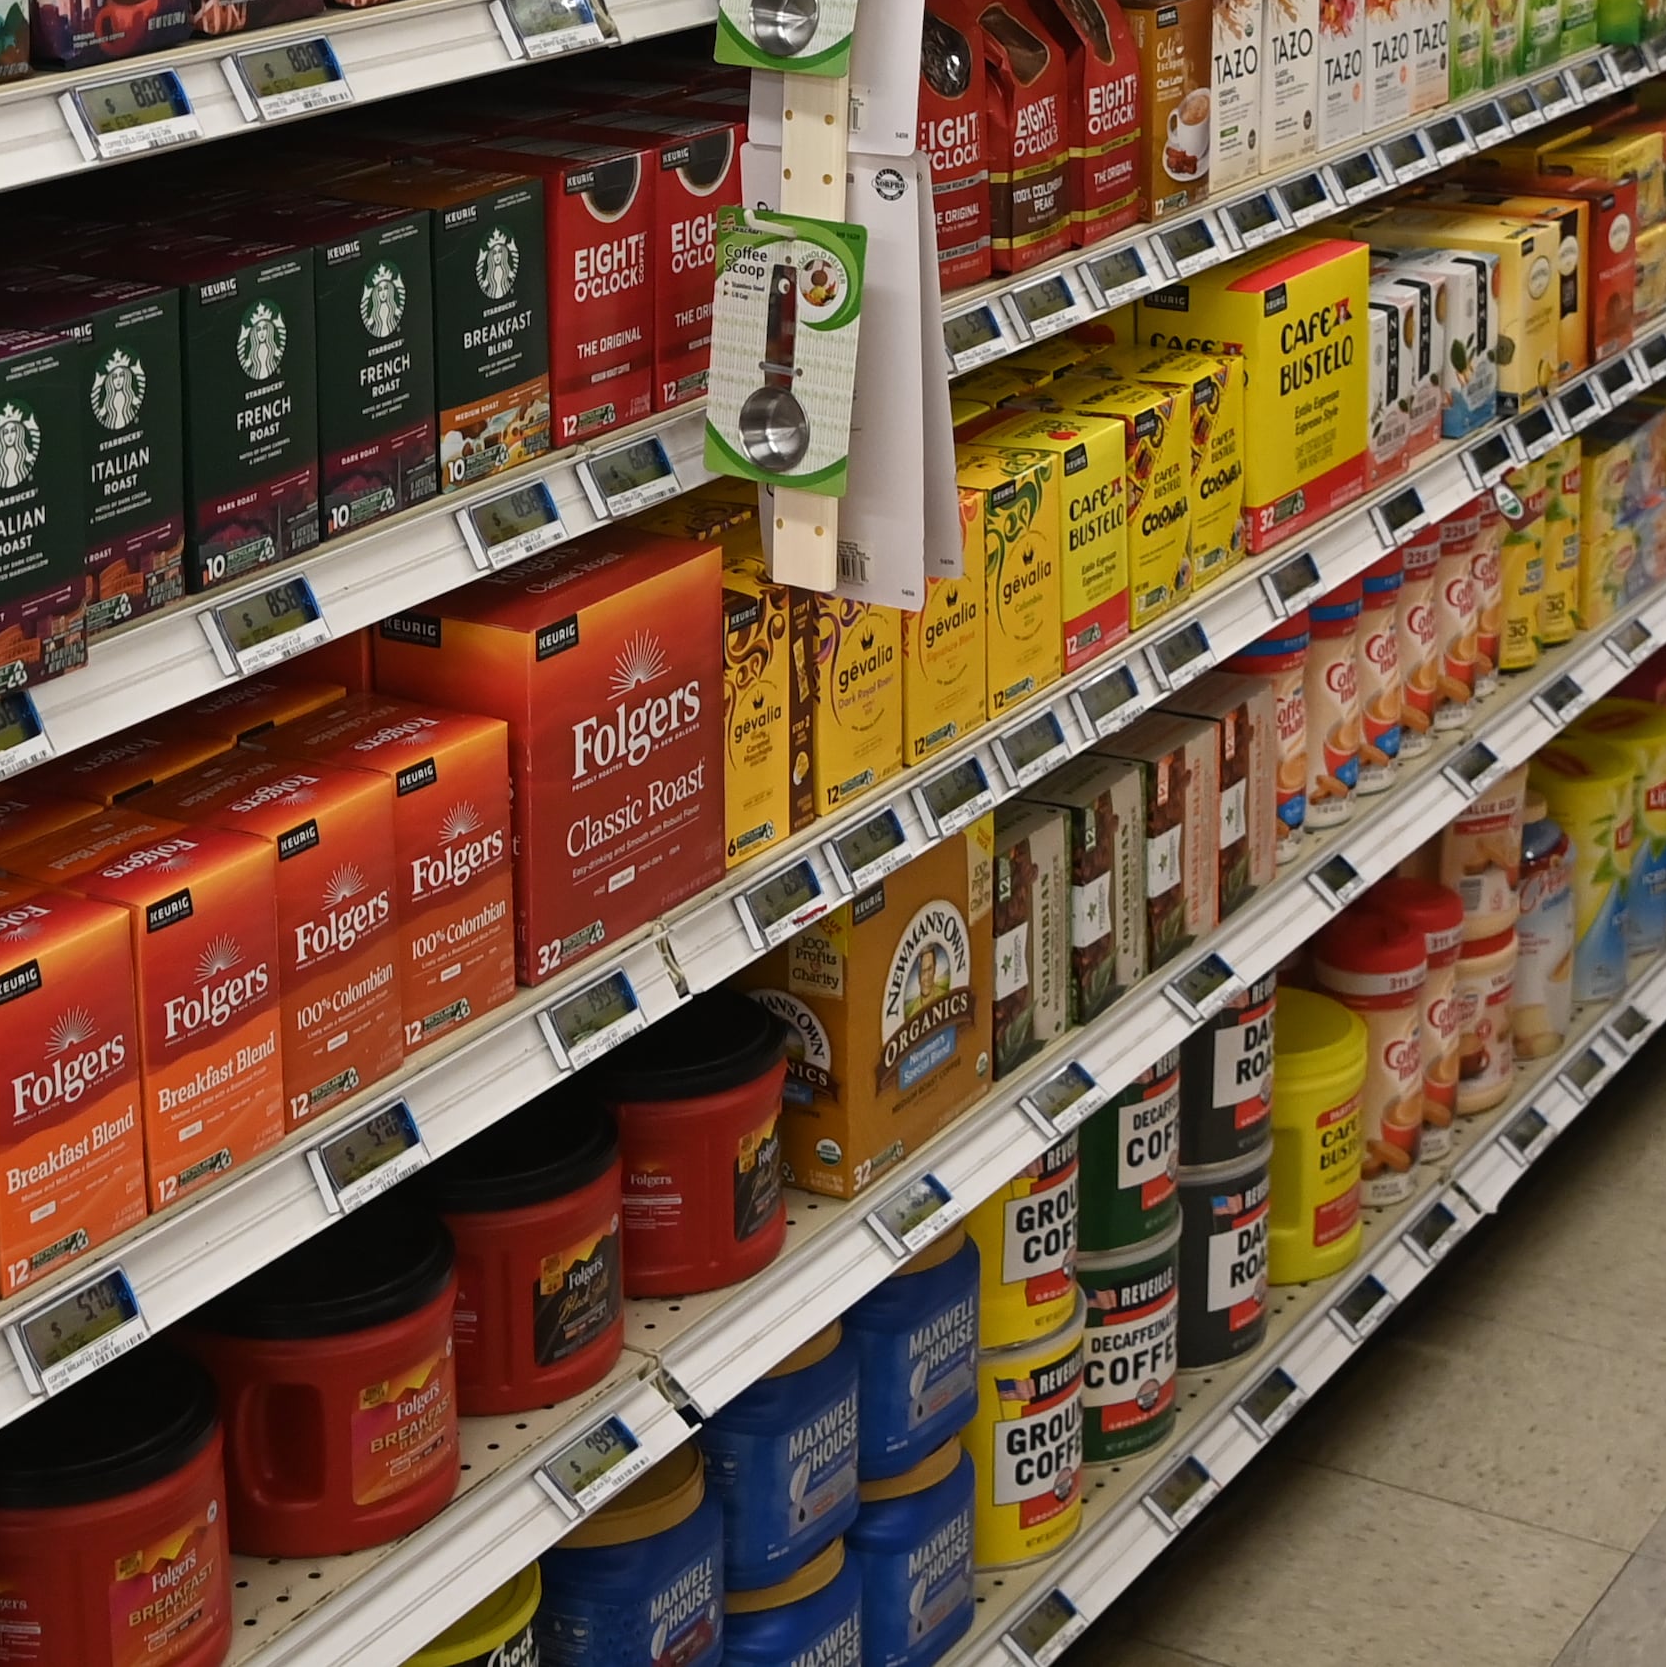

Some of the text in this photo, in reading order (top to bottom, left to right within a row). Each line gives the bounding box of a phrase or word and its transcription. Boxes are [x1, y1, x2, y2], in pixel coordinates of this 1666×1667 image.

[1214, 45, 1258, 85] TAZO
[1271, 28, 1313, 65] TAZO
[1324, 50, 1362, 86] TAZO
[1372, 32, 1410, 68] TAZO
[1088, 74, 1136, 115] EIGHT
[573, 234, 639, 283] EIGHT
[573, 269, 639, 303] O'CLOCK
[463, 310, 533, 349] BREAKFAST
[487, 339, 514, 357] BLEND
[577, 327, 642, 360] THE ORIGINAL
[359, 353, 411, 387] FRENCH
[1279, 334, 1354, 397] BUSTELO
[236, 396, 292, 431] FRENCH
[90, 447, 150, 483] ITALIAN
[1068, 502, 1125, 553] BUSTELO
[1259, 508, 1276, 533] 32
[537, 622, 577, 651] KEURIG
[571, 678, 701, 780] Folgers
[566, 757, 706, 859] Classic Roast
[410, 825, 504, 896] Folgers
[294, 892, 390, 964] Folgers
[411, 897, 506, 961] 100% Colombian
[536, 942, 562, 977] 32
[163, 959, 269, 1041] Folgers
[296, 959, 394, 1031] 100% Colombian
[883, 991, 971, 1068] ORGANICS
[12, 1031, 126, 1118] Folgers
[157, 1031, 275, 1114] Breakfast Blend
[6, 1104, 134, 1196] Breakfast Blend
[908, 1296, 975, 1360] MAXWELL
[927, 1319, 975, 1373] HOUSE
[370, 1394, 453, 1456] BREAKFAST
[787, 1394, 858, 1464] MAXWELL
[809, 1418, 857, 1478] HOUSE
[128, 1560, 215, 1626] BREAKFAST
